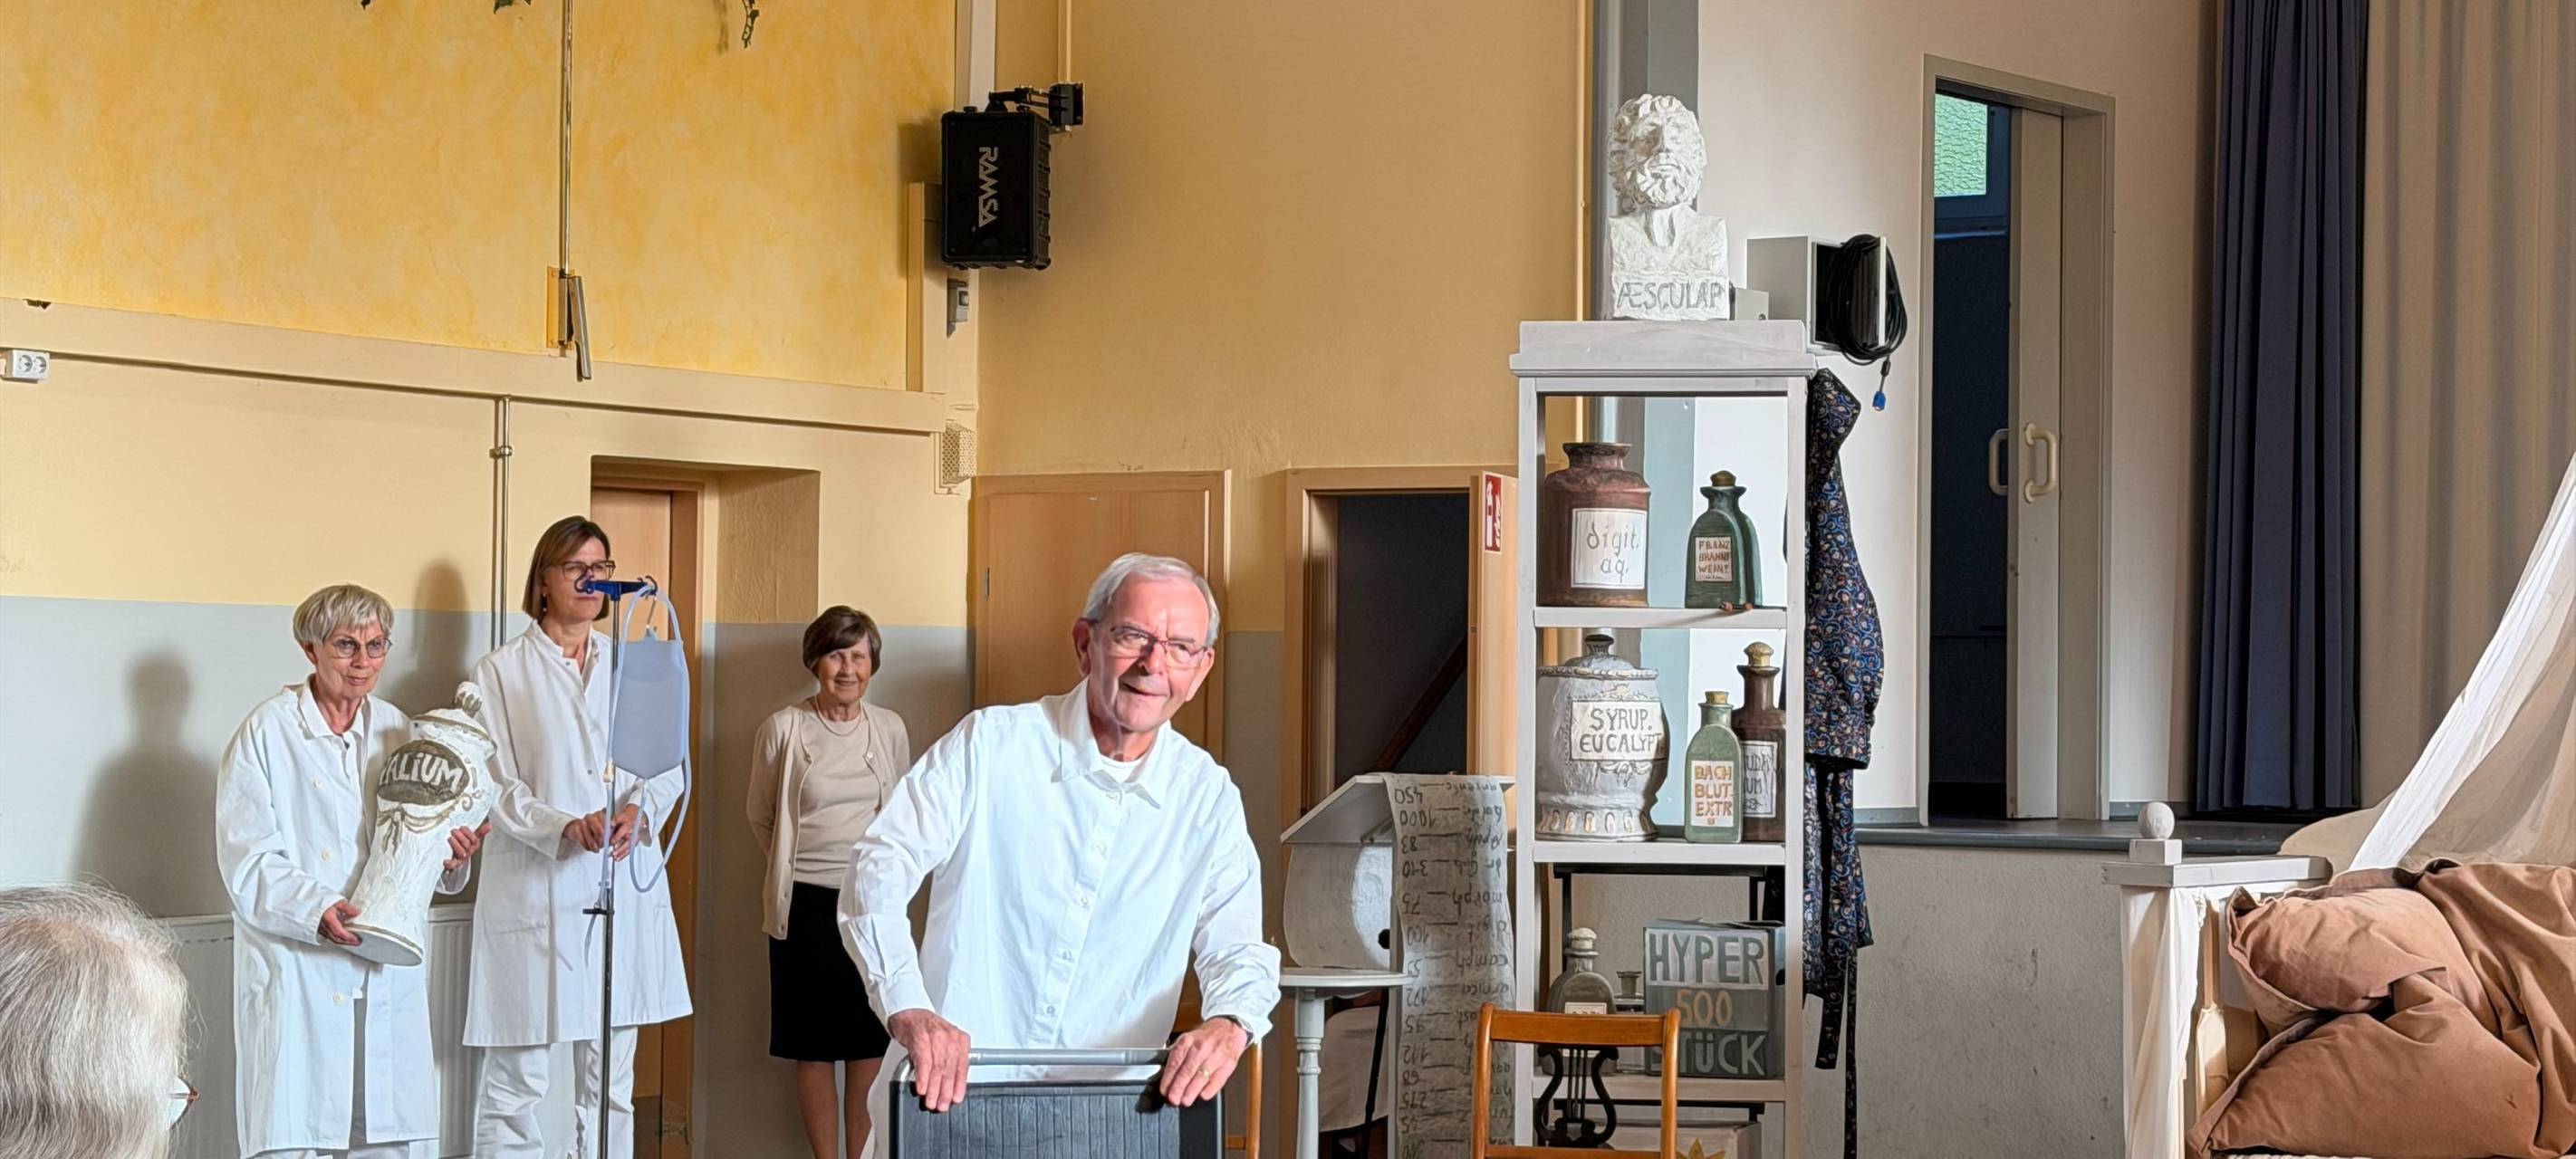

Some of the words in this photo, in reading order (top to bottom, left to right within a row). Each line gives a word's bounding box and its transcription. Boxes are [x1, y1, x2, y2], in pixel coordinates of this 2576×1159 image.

[978, 146, 999, 228] RAMSA
[1694, 765, 1733, 781] BACH
[1394, 786, 1423, 805] 450
[1399, 809, 1437, 829] 1000
[1400, 835, 1418, 854] 83
[1402, 892, 1421, 915] 75
[1407, 925, 1428, 946] 100
[1648, 932, 1764, 984] HYPER
[1677, 989, 1733, 1027] 500
